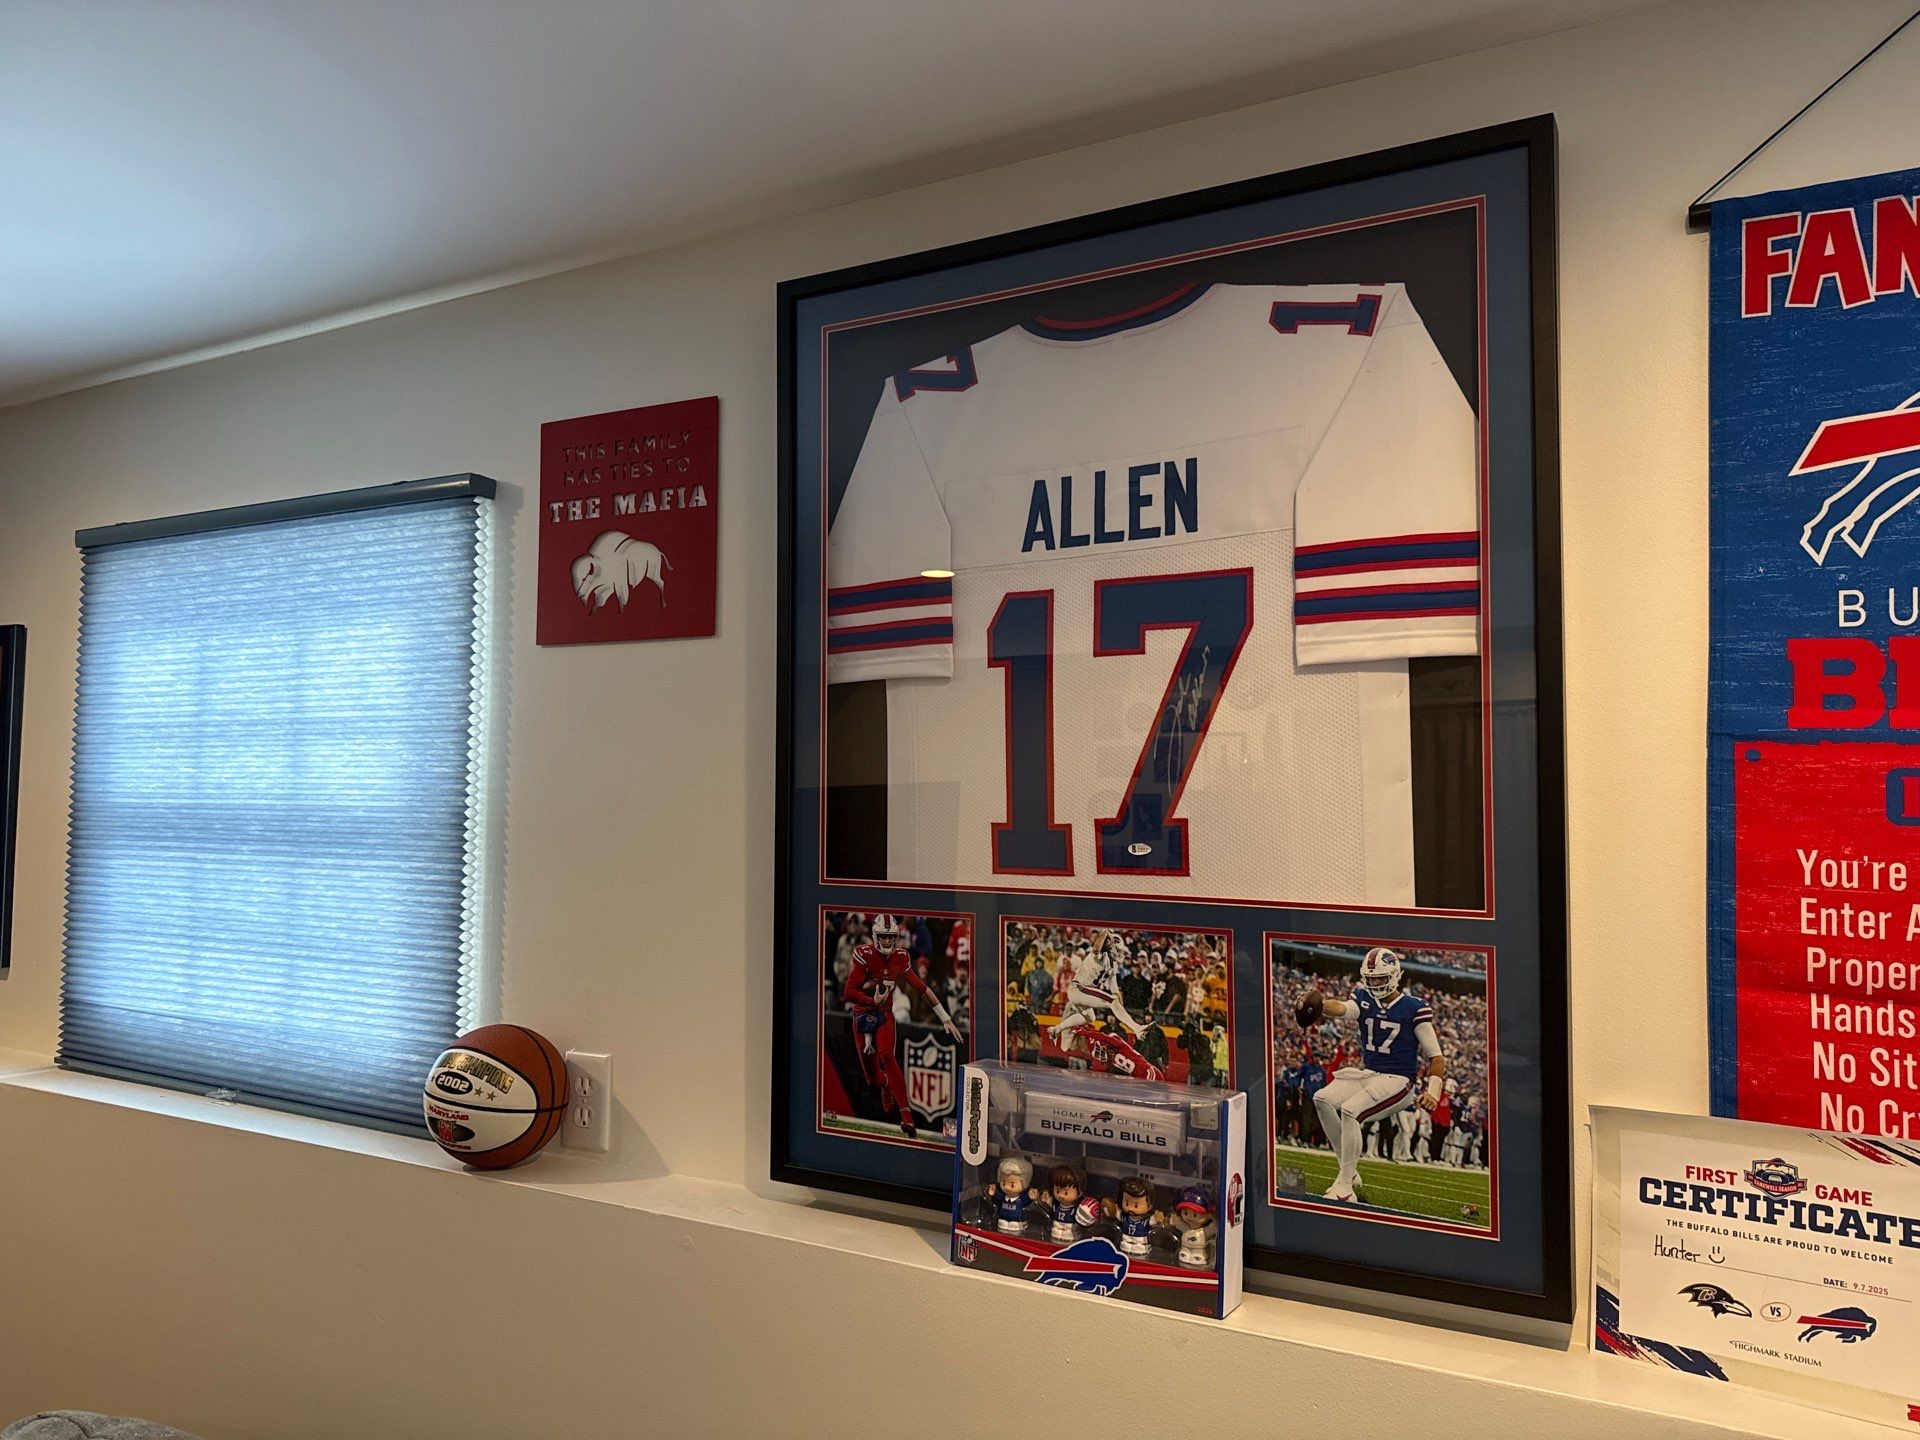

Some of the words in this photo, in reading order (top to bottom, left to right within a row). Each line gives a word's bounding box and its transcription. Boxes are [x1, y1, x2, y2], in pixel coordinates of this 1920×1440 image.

[1741, 193, 1920, 318] FAN
[562, 442, 606, 463] THIS
[614, 430, 691, 457] FAMILY
[563, 467, 602, 487] HAS
[610, 460, 654, 480] TIES
[662, 454, 690, 474] TO
[548, 496, 601, 522] THE
[612, 483, 708, 516] MAFIA
[1022, 457, 1198, 552] ALLEN
[987, 567, 1254, 877] 17
[1796, 848, 1907, 892] You're
[1800, 897, 1893, 940] Enter
[1806, 946, 1920, 996] Proper
[1810, 992, 1917, 1039] Hands
[1365, 1018, 1401, 1055] 17
[437, 1074, 471, 1092] 2002
[1812, 1041, 1857, 1084] No
[1869, 1047, 1919, 1090] Sit
[911, 1070, 948, 1107] NFL
[429, 1104, 469, 1120] MARYLAND
[1053, 1108, 1085, 1120] HOME
[1117, 1118, 1130, 1126] OF
[1136, 1120, 1157, 1130] THE
[1820, 1091, 1865, 1135] No
[1879, 1099, 1920, 1140] Cr
[1041, 1119, 1114, 1139] BUFFALO
[1120, 1131, 1167, 1147] BILLS
[1685, 1165, 1738, 1186] FIRST
[1815, 1184, 1873, 1207] GAME
[1638, 1176, 1920, 1250] CERTIFICATE
[1654, 1233, 1701, 1263] Hunter
[1666, 1218, 1684, 1228] THE
[1687, 1222, 1729, 1236] BUFFALO
[1732, 1231, 1760, 1241] BILLS
[1763, 1235, 1783, 1245] ARE
[1786, 1239, 1820, 1252] PROUD
[1823, 1245, 1837, 1255] TO
[1840, 1248, 1894, 1265] WELCOME
[1823, 1277, 1848, 1288] DATE:
[1852, 1282, 1889, 1295] 9.7.2025
[1770, 1305, 1782, 1317] VS
[1732, 1341, 1781, 1359] HIGHMARK
[1784, 1352, 1822, 1368] STADIUM
